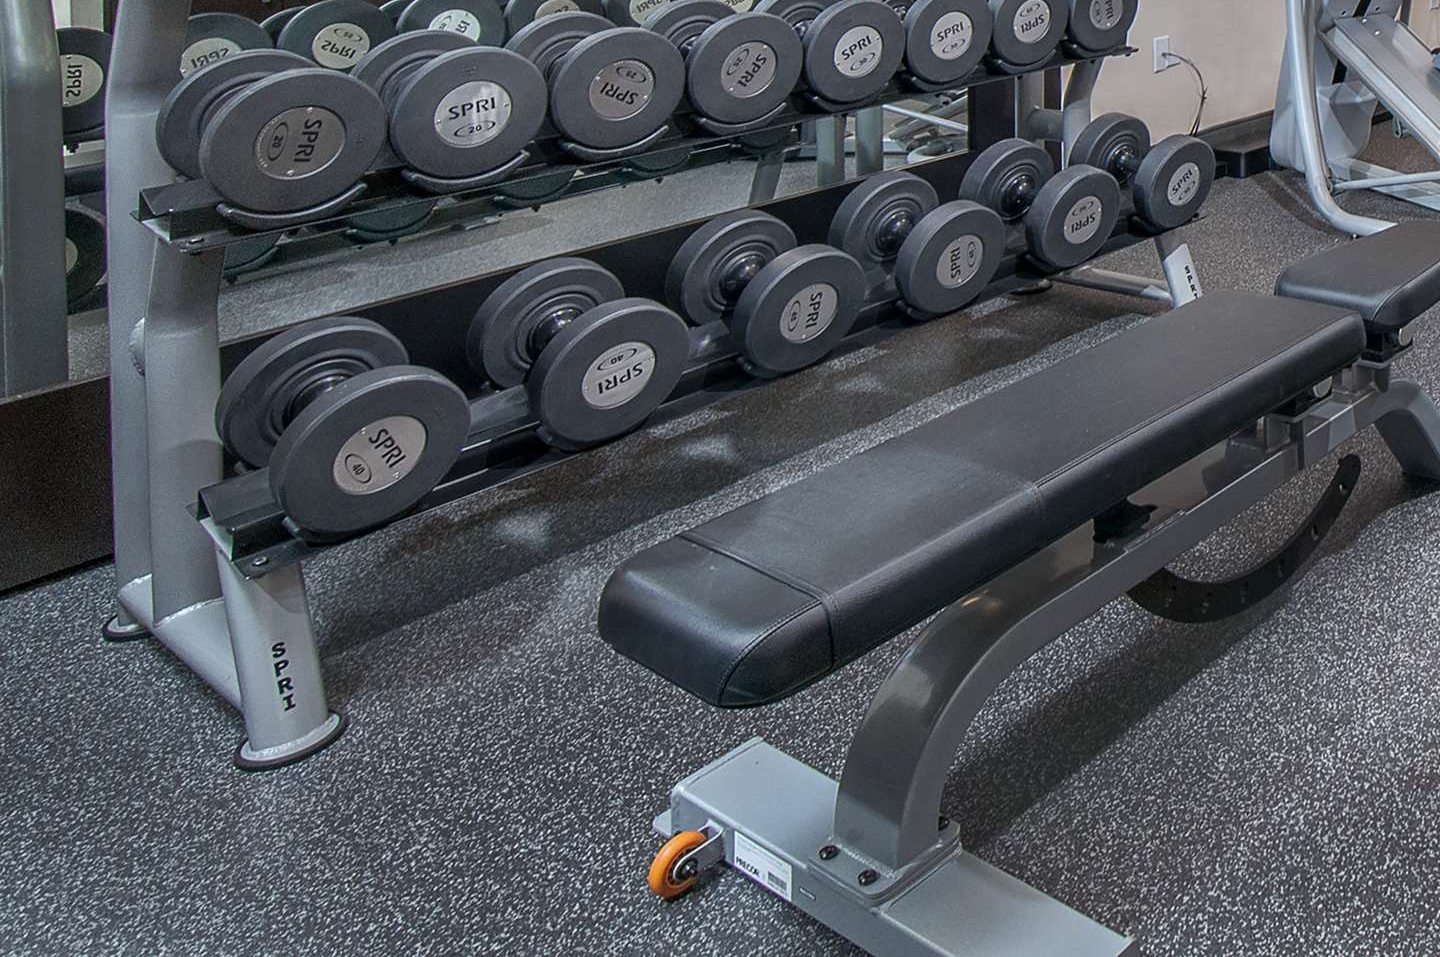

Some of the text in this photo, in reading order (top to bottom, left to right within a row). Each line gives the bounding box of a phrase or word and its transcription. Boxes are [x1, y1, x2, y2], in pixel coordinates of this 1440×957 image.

[937, 21, 965, 42] SPRI
[1021, 14, 1045, 33] SPRI
[842, 35, 872, 60] SPRI
[737, 54, 768, 88] SPRI
[600, 82, 639, 105] SPRI
[447, 97, 497, 120] SPRI
[467, 123, 482, 133] 20
[273, 135, 283, 150] 20
[294, 118, 322, 163] SPRI
[1173, 169, 1193, 194] SPRI
[1071, 214, 1095, 233] SPRI
[950, 246, 960, 278] SPRI
[806, 291, 822, 329] SPRI
[610, 356, 626, 366] 40
[598, 362, 644, 395] SPRI
[369, 427, 406, 469] SPRI
[352, 463, 365, 475] 40
[270, 641, 297, 711] SPRI
